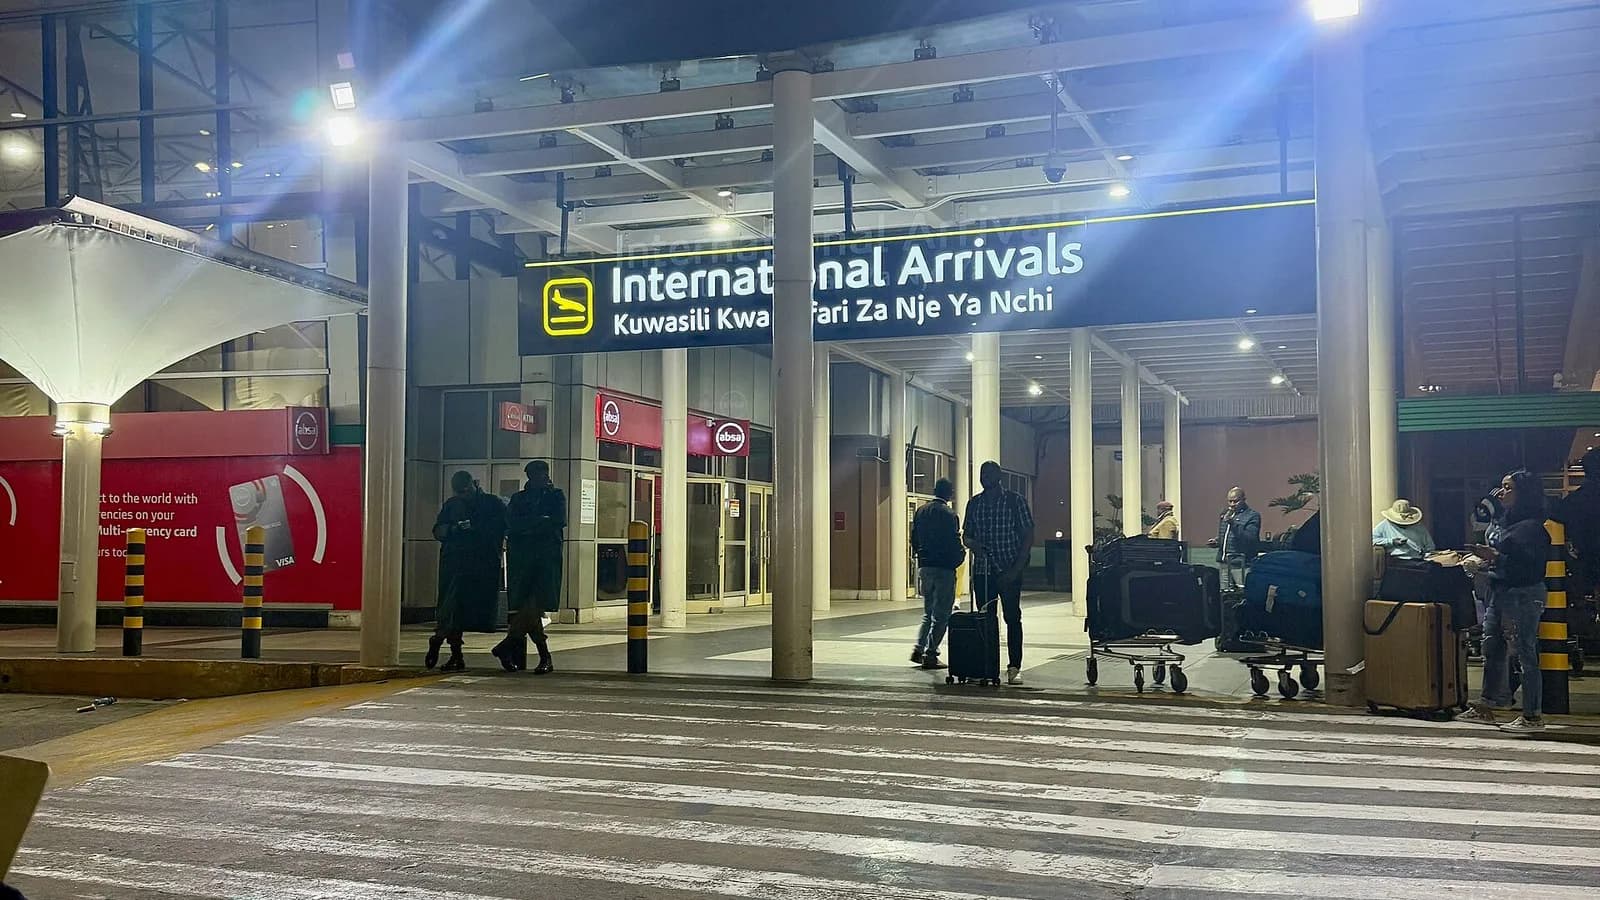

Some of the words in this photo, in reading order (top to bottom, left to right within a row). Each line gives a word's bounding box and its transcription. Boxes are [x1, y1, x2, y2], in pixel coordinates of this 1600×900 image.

[612, 246, 886, 304] Internatnal
[897, 232, 1084, 285] Arrivals
[614, 307, 710, 336] Kuwasili
[717, 307, 770, 331] Kwa
[856, 299, 888, 322] Za
[896, 293, 941, 326] Nje
[948, 293, 981, 316] Ya
[990, 286, 1053, 314] Nchi
[719, 431, 742, 443] absa
[109, 494, 120, 504] to
[122, 492, 140, 504] the
[142, 492, 172, 505] world
[174, 493, 198, 505] with
[135, 511, 148, 520] on
[151, 511, 175, 523] your
[173, 526, 198, 537] card
[275, 556, 295, 568] VISA
